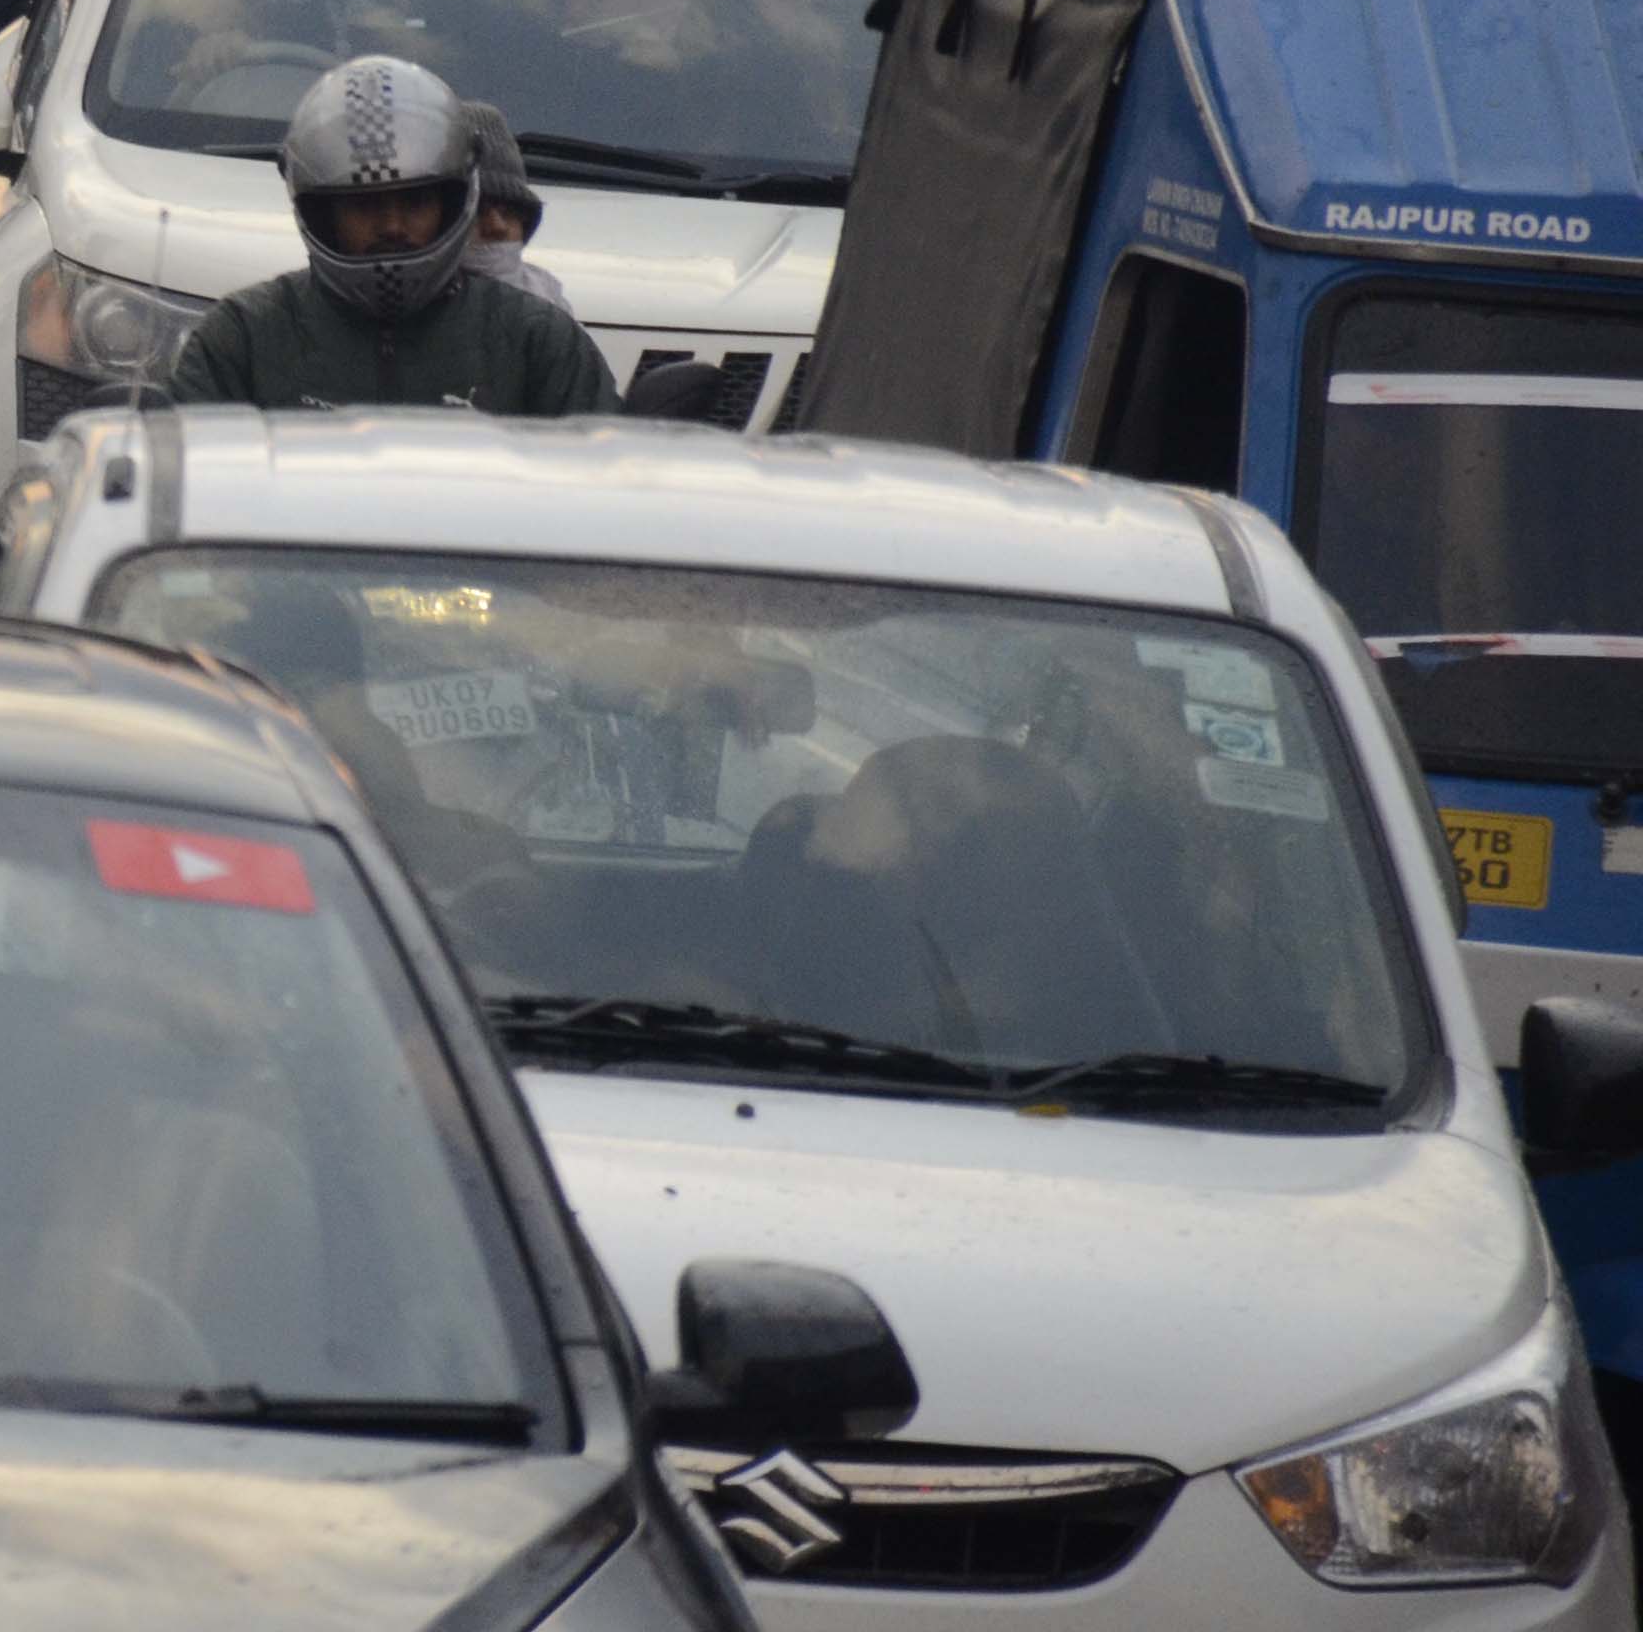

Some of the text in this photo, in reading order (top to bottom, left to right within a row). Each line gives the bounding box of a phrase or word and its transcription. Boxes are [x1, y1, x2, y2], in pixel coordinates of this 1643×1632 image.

[1325, 202, 1592, 243] RAJPUR ROAD
[1446, 826, 1512, 855] 7TB
[1456, 857, 1512, 889] 60
